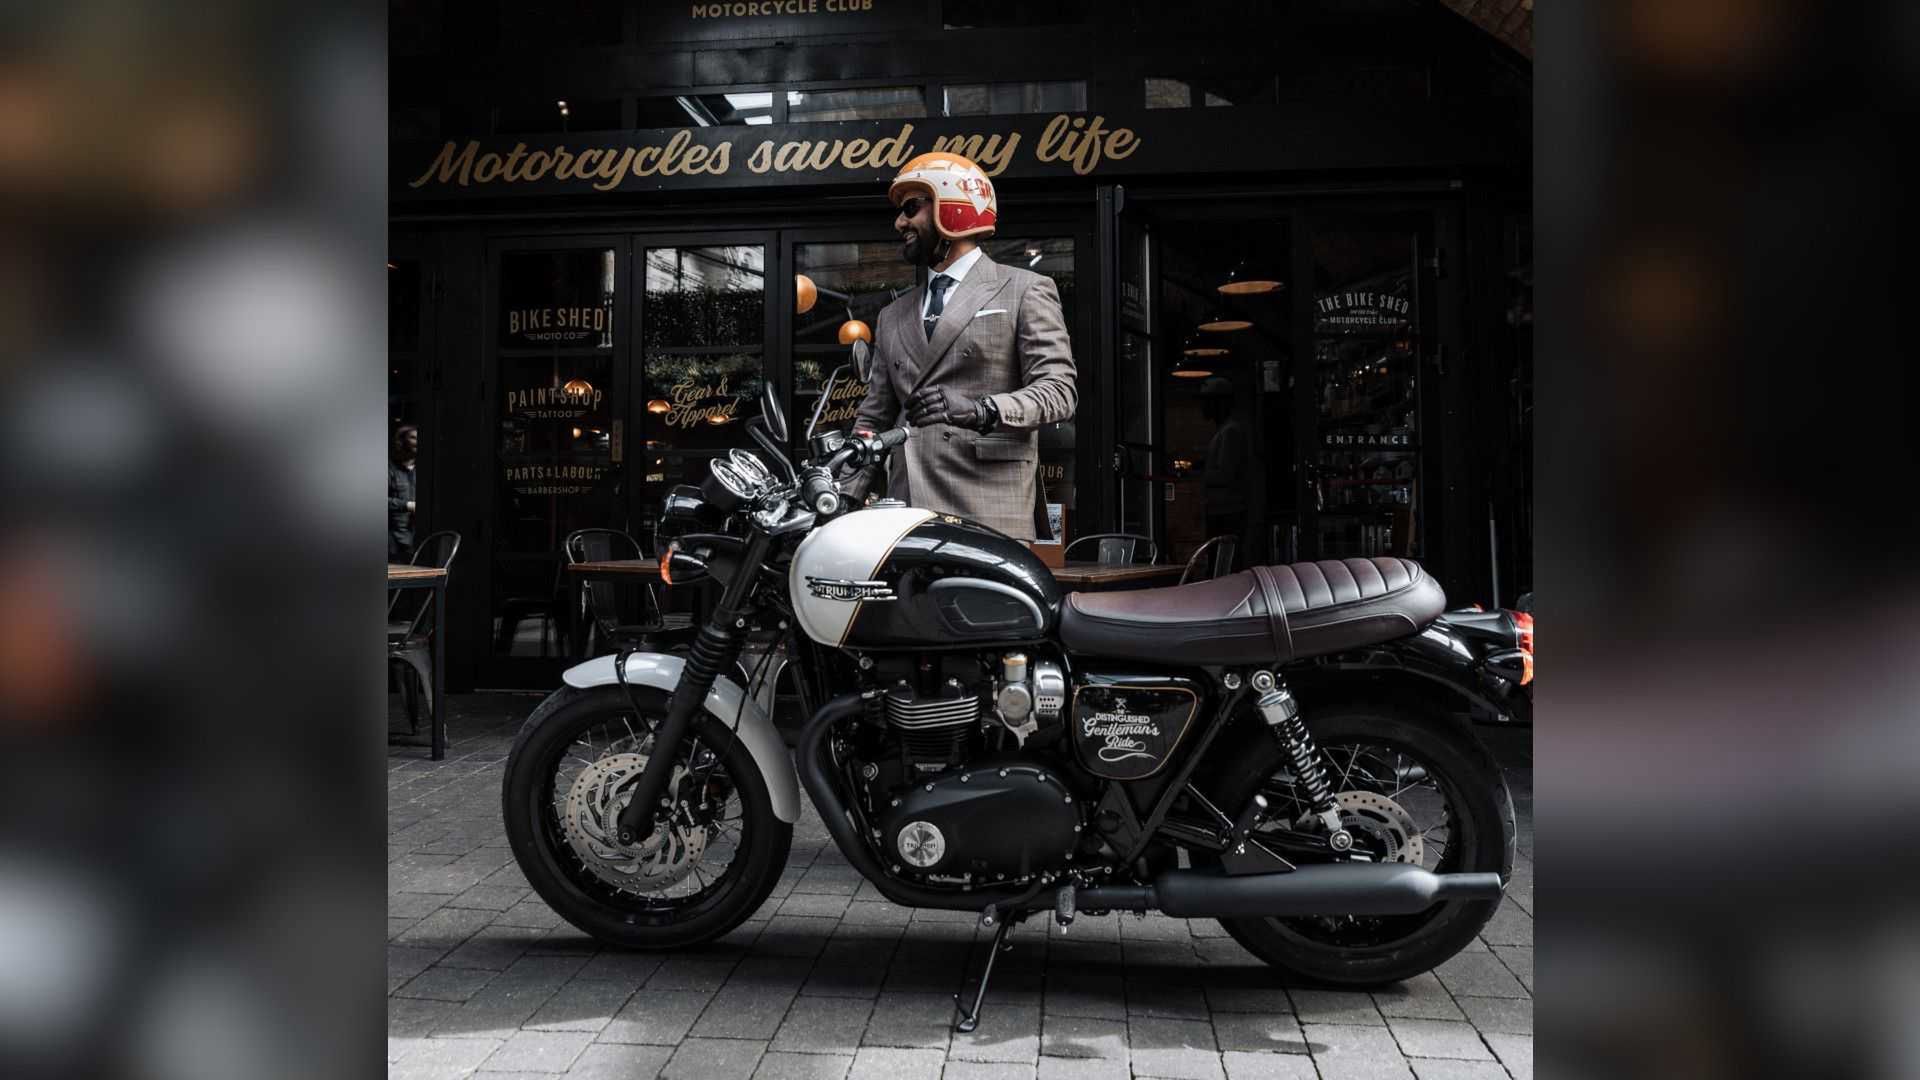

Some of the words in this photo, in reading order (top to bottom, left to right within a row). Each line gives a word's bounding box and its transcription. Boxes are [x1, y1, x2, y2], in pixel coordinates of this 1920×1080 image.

[692, 0, 817, 18] MOTORCYCLE
[825, 0, 873, 12] CLUB
[409, 129, 730, 191] Motorcycles
[747, 122, 915, 172] saved
[931, 131, 1022, 177] my
[1035, 113, 1141, 176] life
[1317, 294, 1342, 313] THE
[1345, 291, 1375, 307] BIKE
[1379, 293, 1409, 314] SHED
[509, 307, 553, 335] BIKE
[557, 306, 605, 331] SHED
[536, 331, 562, 341] MOTO
[671, 379, 713, 405] Gear
[715, 375, 729, 398] &
[664, 397, 741, 430] Apparel
[1326, 434, 1409, 445] ENTRANCE
[506, 465, 545, 481] PARTS
[554, 465, 601, 481] LABOUR
[1082, 717, 1161, 737] Gentleman's
[1105, 734, 1137, 750] Ride
